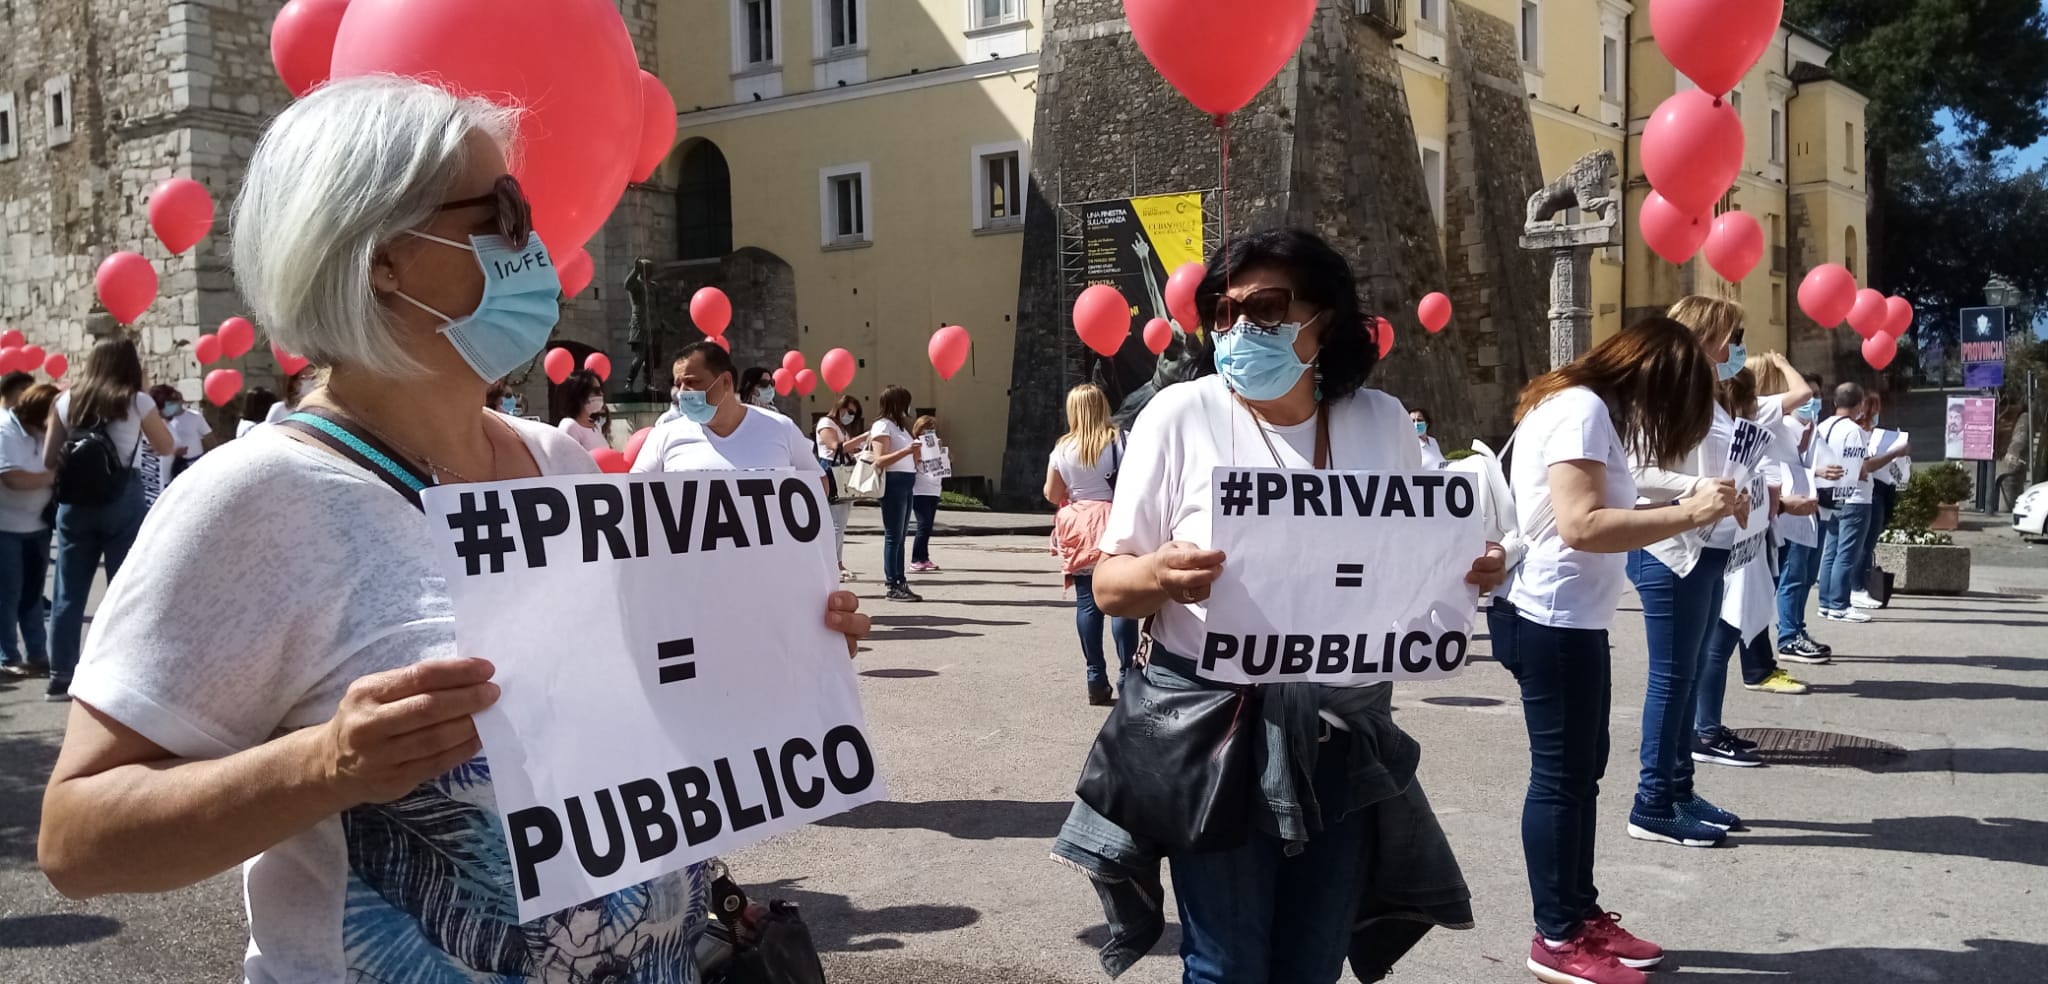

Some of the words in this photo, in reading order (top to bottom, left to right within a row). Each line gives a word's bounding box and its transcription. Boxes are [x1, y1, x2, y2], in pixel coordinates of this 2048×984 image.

[1087, 211, 1100, 219] UNA
[1101, 209, 1127, 217] FINESTRA
[1104, 216, 1126, 224] DANZA
[494, 251, 553, 280] INFE
[1962, 340, 2004, 361] PROVINCIA
[1220, 471, 1474, 518] #PRIVATO
[447, 477, 822, 576] #PRIVATO
[1201, 630, 1467, 676] PUBBLICO
[507, 724, 875, 901] PUBBLICO
